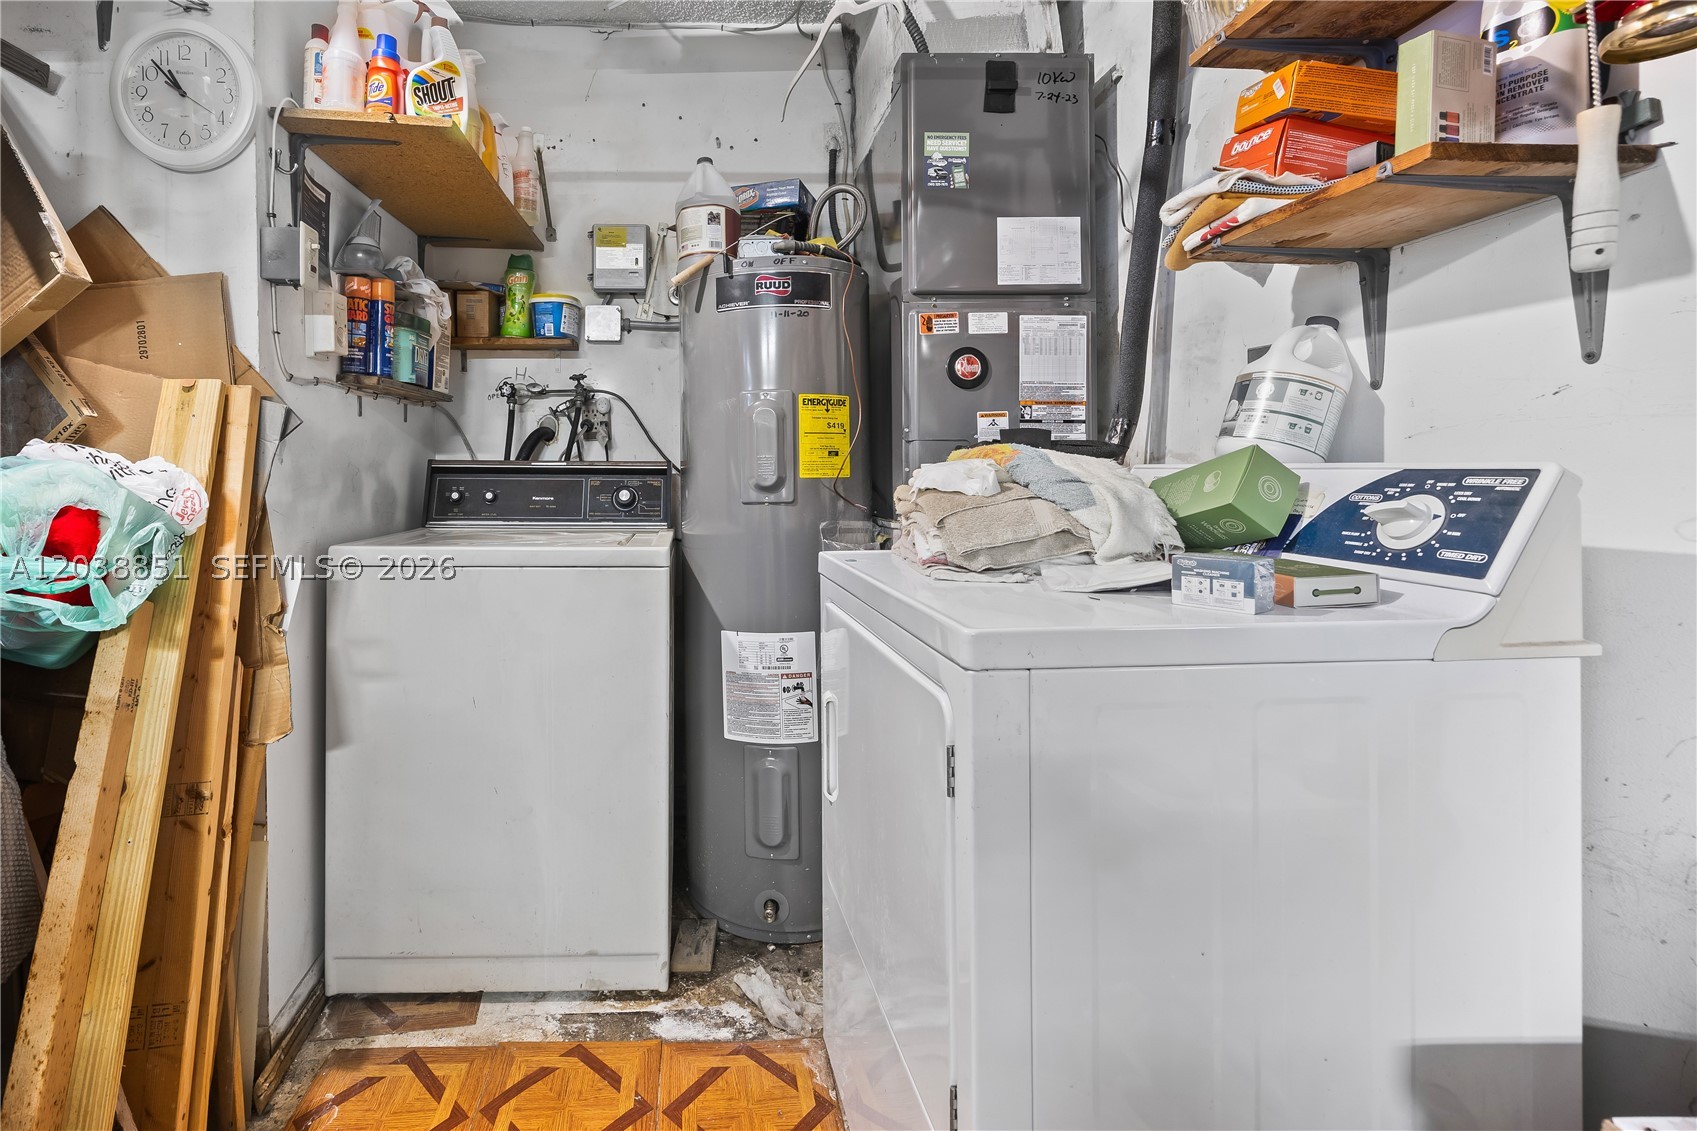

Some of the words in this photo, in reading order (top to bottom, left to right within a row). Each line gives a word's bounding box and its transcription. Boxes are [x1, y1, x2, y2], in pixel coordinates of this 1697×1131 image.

[160, 50, 169, 66] 11
[178, 44, 191, 60] 12
[142, 65, 158, 81] 10
[216, 68, 226, 84] 2
[136, 85, 148, 101] 9
[368, 82, 384, 95] Tide
[413, 77, 456, 106] SHOUT
[1508, 76, 1549, 94] REMOVER
[223, 88, 234, 104] 3
[142, 106, 154, 122] 8
[217, 110, 225, 125] 4
[161, 123, 169, 138] 7
[179, 130, 191, 145] 6
[200, 125, 212, 140] 5
[1231, 128, 1274, 156] bounce
[508, 275, 528, 286] Gain
[756, 281, 790, 290] RUUD
[136, 320, 148, 360] 29702801
[516, 367, 527, 380] H
[957, 358, 979, 375] Rheem
